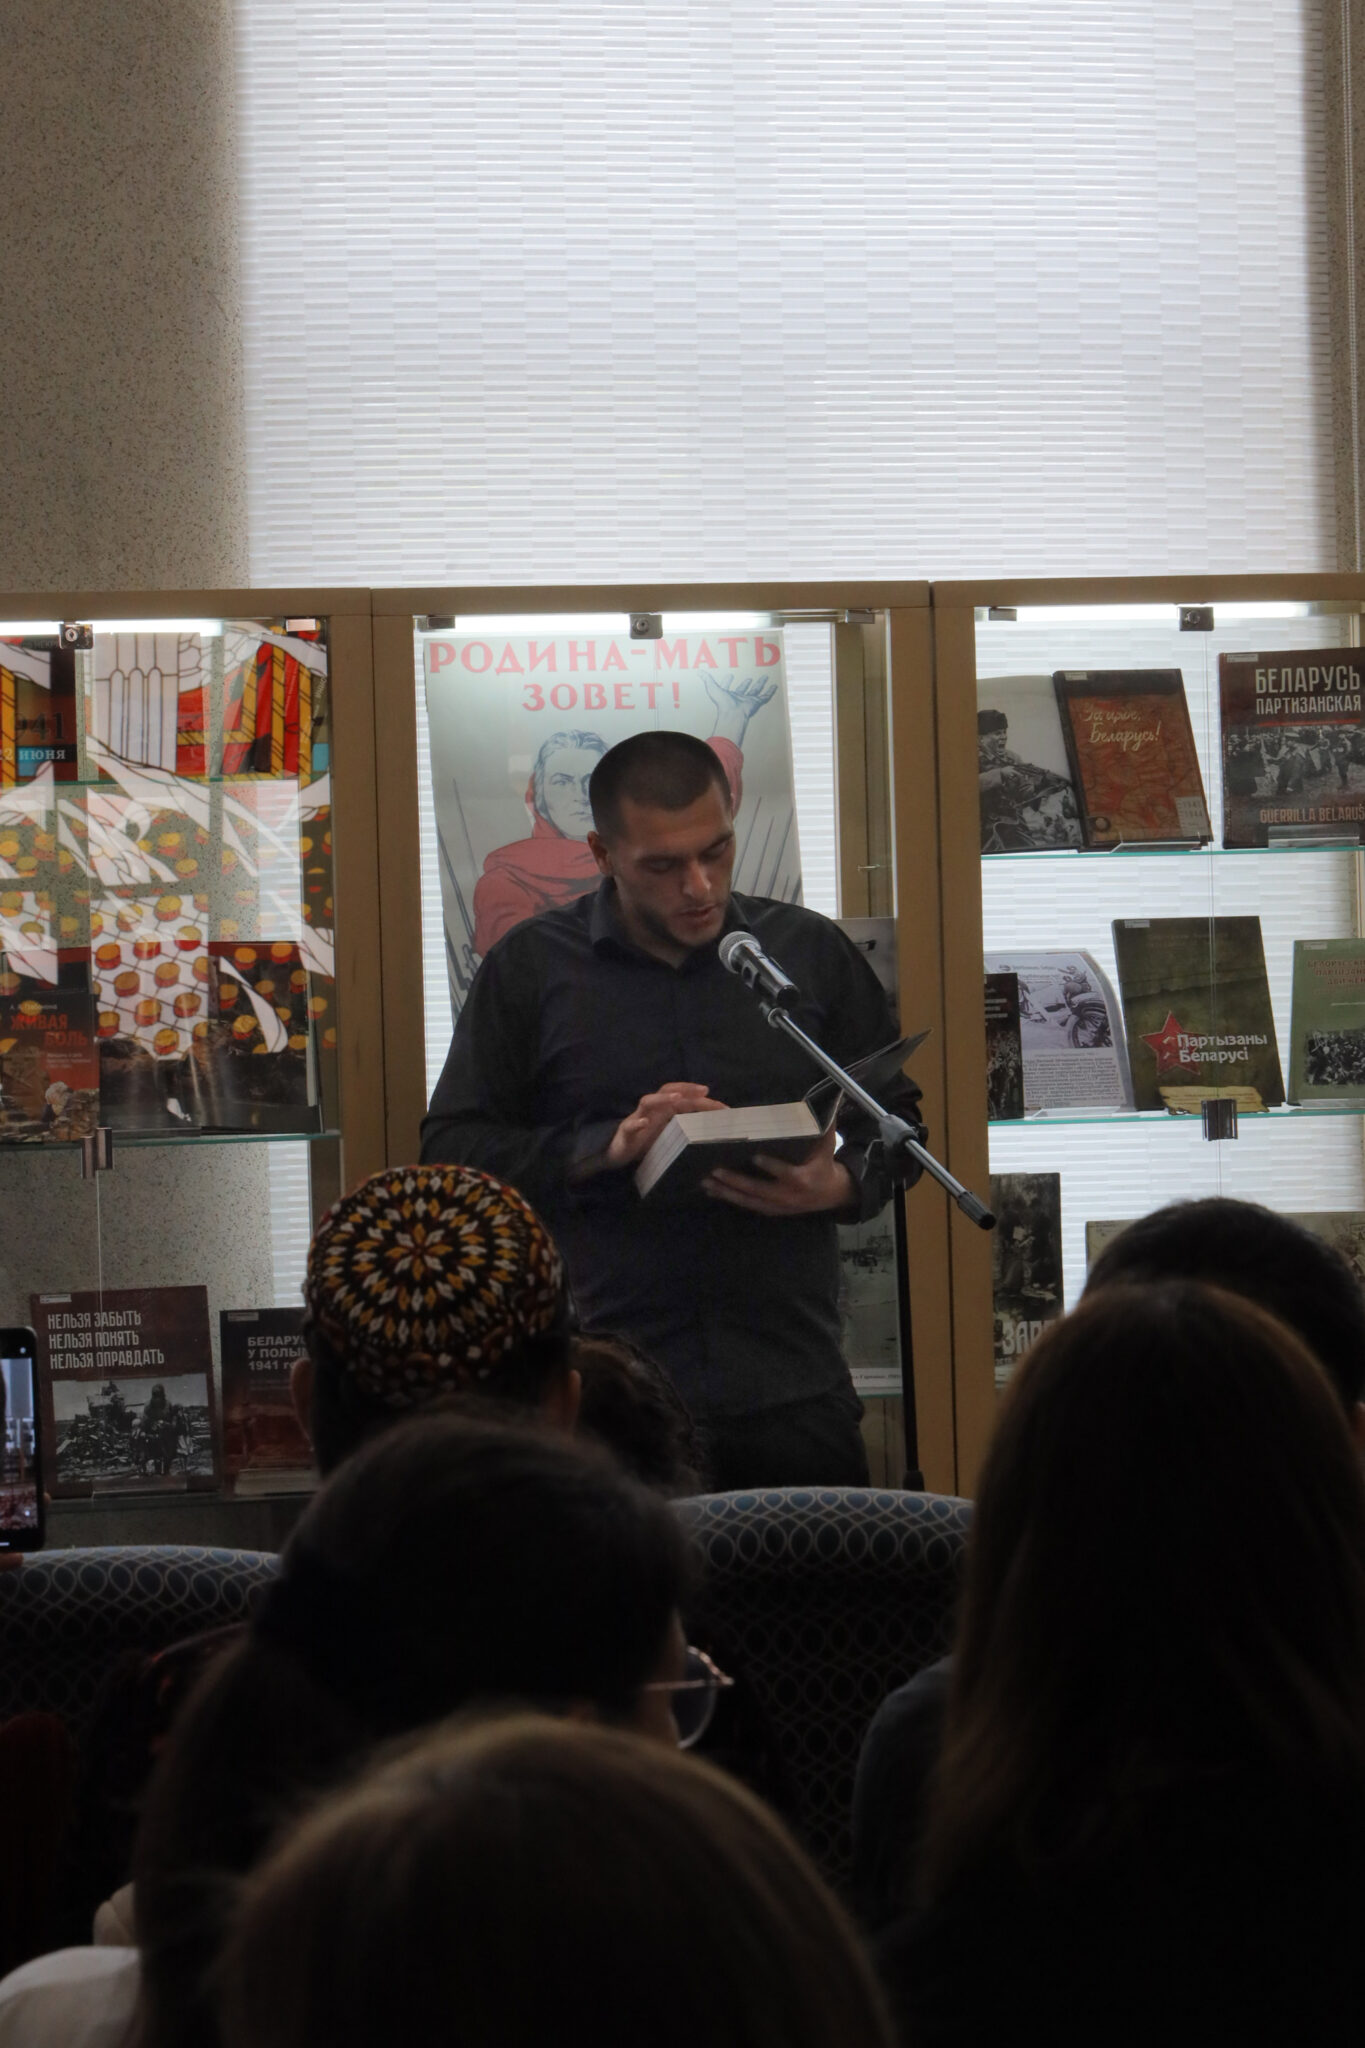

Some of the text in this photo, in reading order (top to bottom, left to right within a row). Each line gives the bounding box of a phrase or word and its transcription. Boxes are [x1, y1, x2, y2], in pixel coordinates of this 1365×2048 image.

[428, 636, 781, 676] РОДИНА-МАТЬ
[1255, 665, 1361, 693] БЕЛАРУСЬ
[521, 682, 681, 712] ЗОВЕТ!
[1255, 695, 1362, 715] ПАРТИЗАНСКАЯ
[1088, 720, 1162, 752] Беларусь!
[1259, 808, 1315, 823] GUERRILLA
[1177, 1034, 1267, 1049] Партызаны
[1179, 1047, 1249, 1064] Беларусі
[48, 1310, 142, 1329] НЕЛЬЗЯ ЗАБЫТЬ
[49, 1330, 140, 1349] НЕЛЬЗЯ ПОНЯТЬ
[247, 1335, 306, 1347] БЕЛАРУС
[50, 1349, 165, 1370] НЕЛЬЗЯ ОПРАВДАТЬ
[248, 1349, 256, 1359] У
[248, 1360, 279, 1371] 1941
